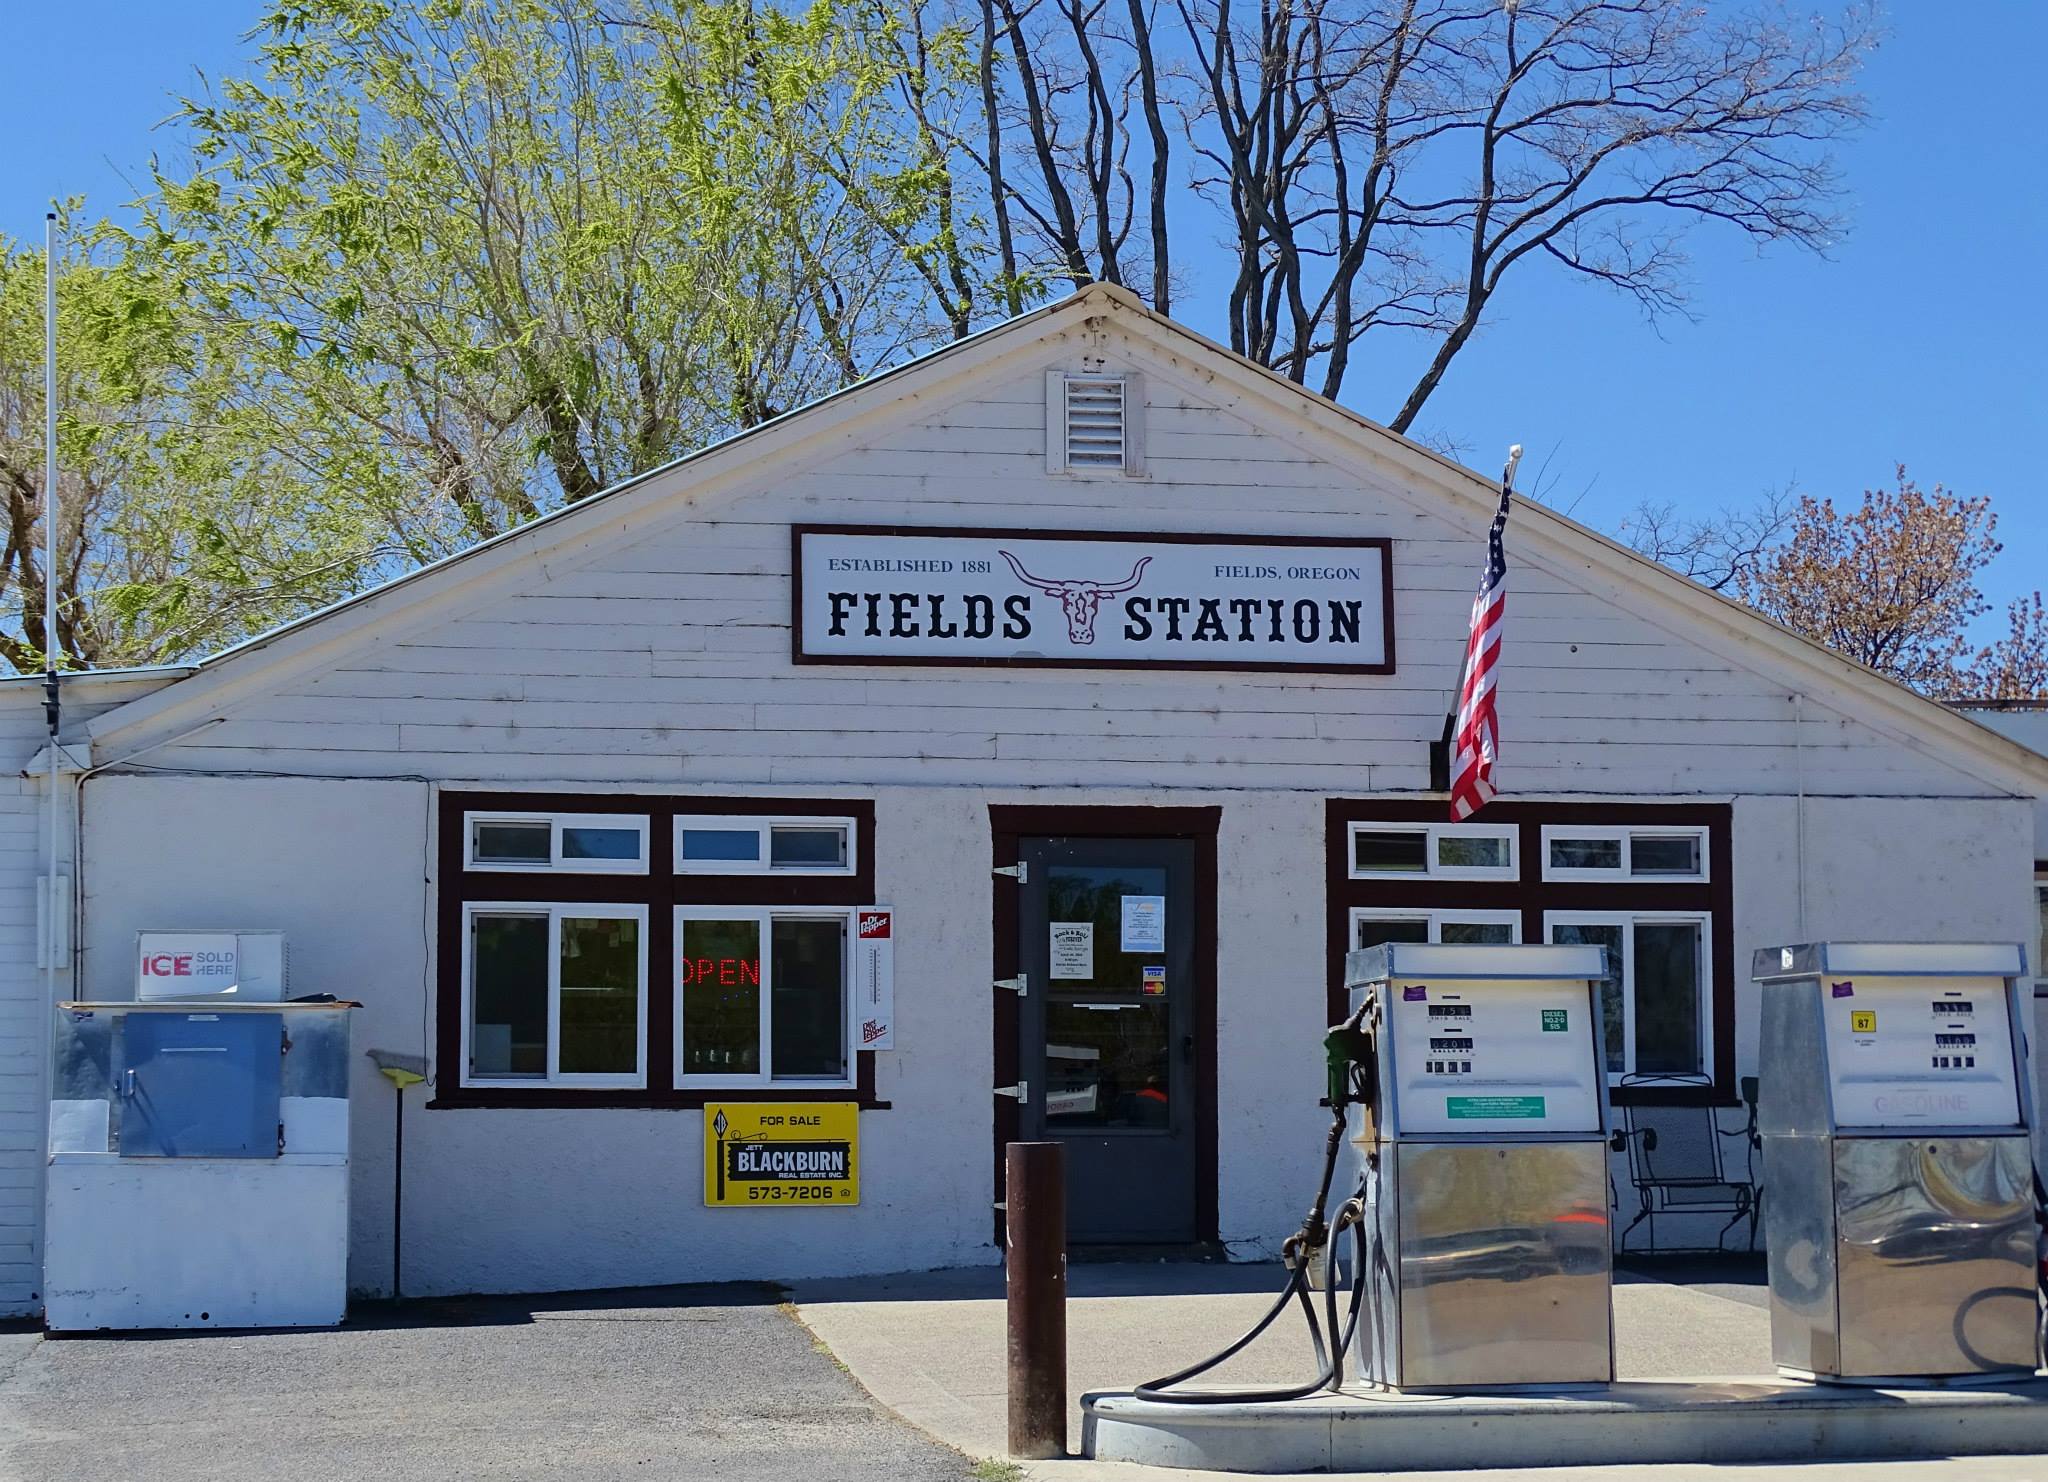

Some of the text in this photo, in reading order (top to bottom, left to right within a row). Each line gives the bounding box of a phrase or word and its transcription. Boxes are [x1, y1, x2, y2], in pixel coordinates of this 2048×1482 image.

[828, 559, 991, 573] ESTABLISHED 1881
[1215, 565, 1360, 580] FIELDS, OREGON
[828, 592, 1362, 643] FIELDS STATION
[861, 918, 887, 934] Pepper
[868, 916, 878, 925] Dr
[196, 952, 234, 962] SOLD
[143, 952, 192, 976] ICE
[196, 965, 232, 975] HERE
[1858, 1018, 1869, 1028] 87
[760, 1116, 821, 1125] FOR SALE
[738, 1152, 843, 1171] BLACKBURN
[749, 1187, 832, 1199] 573-7206
